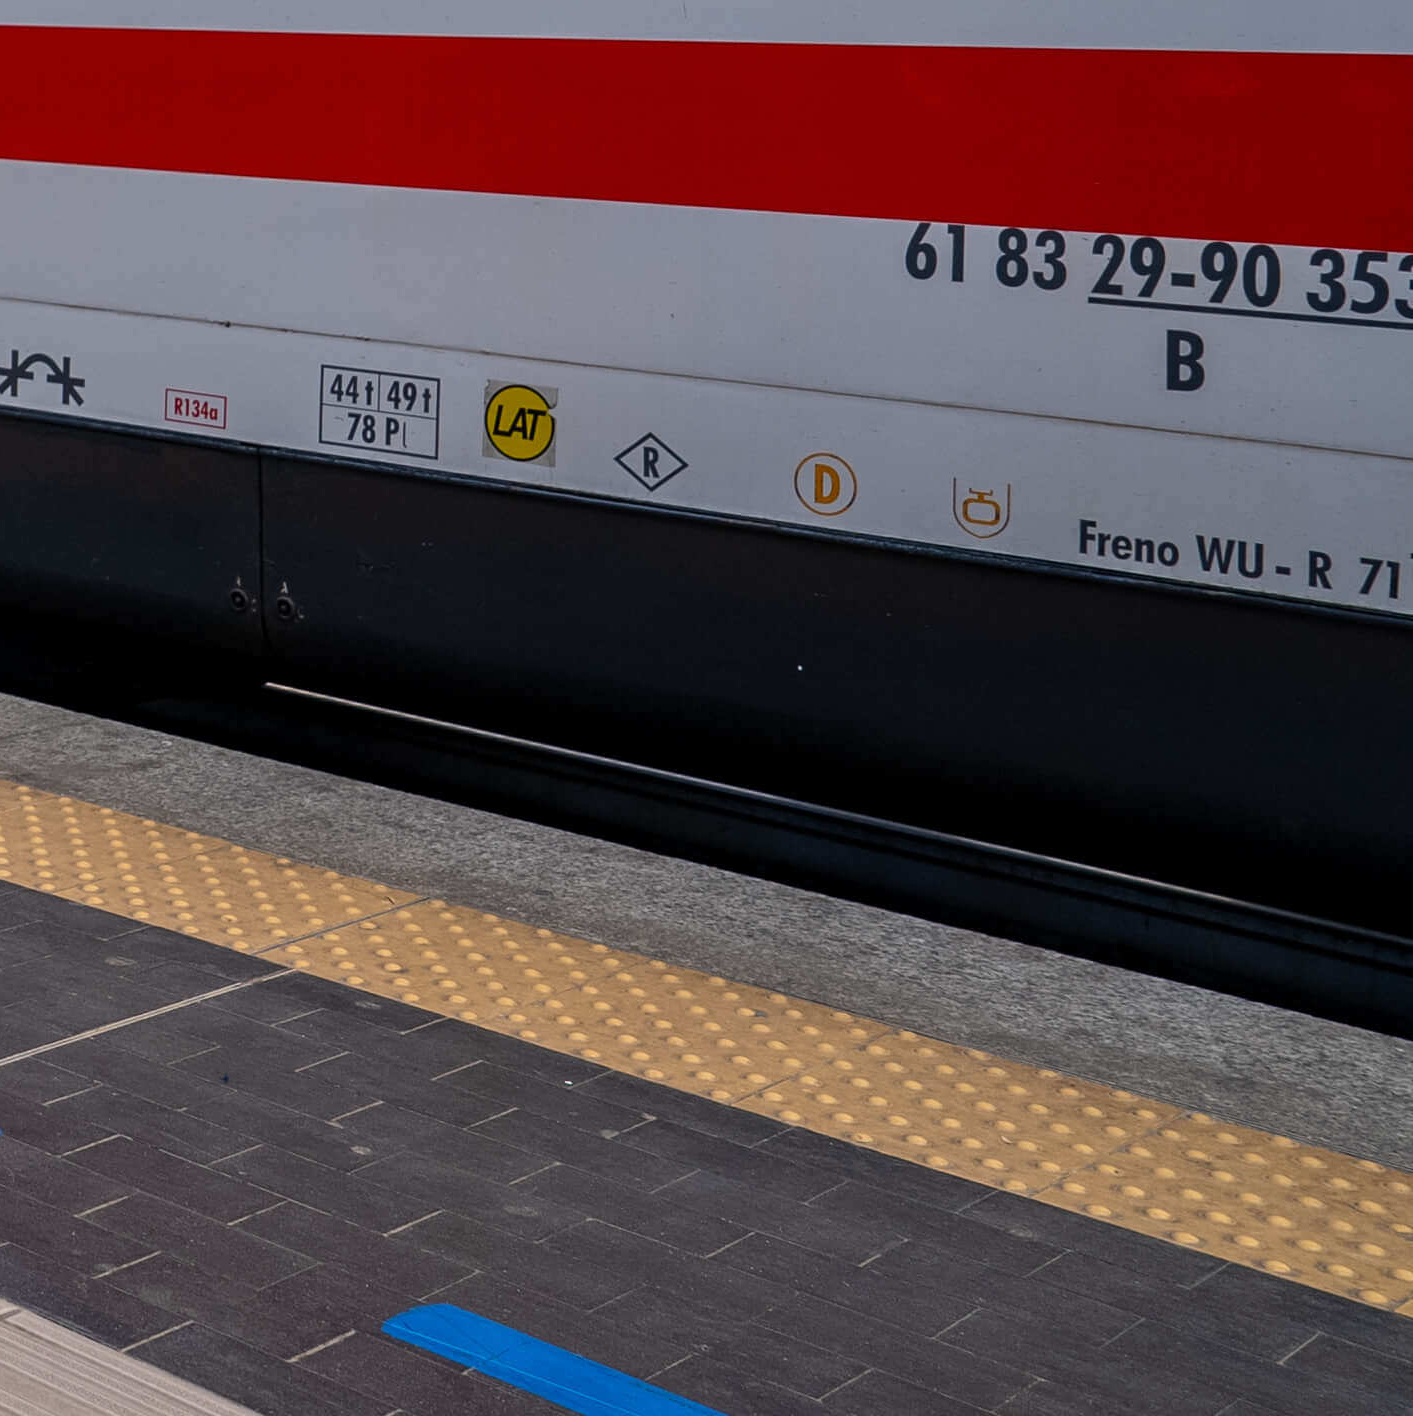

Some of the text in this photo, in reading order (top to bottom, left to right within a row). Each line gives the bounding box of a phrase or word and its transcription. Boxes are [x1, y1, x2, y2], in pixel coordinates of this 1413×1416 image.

[905, 222, 966, 283] 61
[995, 227, 1067, 290] 83
[1090, 234, 1282, 308] 29-90
[1165, 329, 1205, 391] B
[330, 374, 374, 406] 44 t
[387, 381, 432, 413] 49 t
[173, 397, 219, 422] R134a
[493, 404, 547, 441] LAT
[347, 412, 376, 444] 78
[642, 447, 658, 479] R
[814, 463, 840, 505] D
[1078, 519, 1179, 566] Freno
[1196, 535, 1264, 578] WU
[1308, 550, 1333, 590] R
